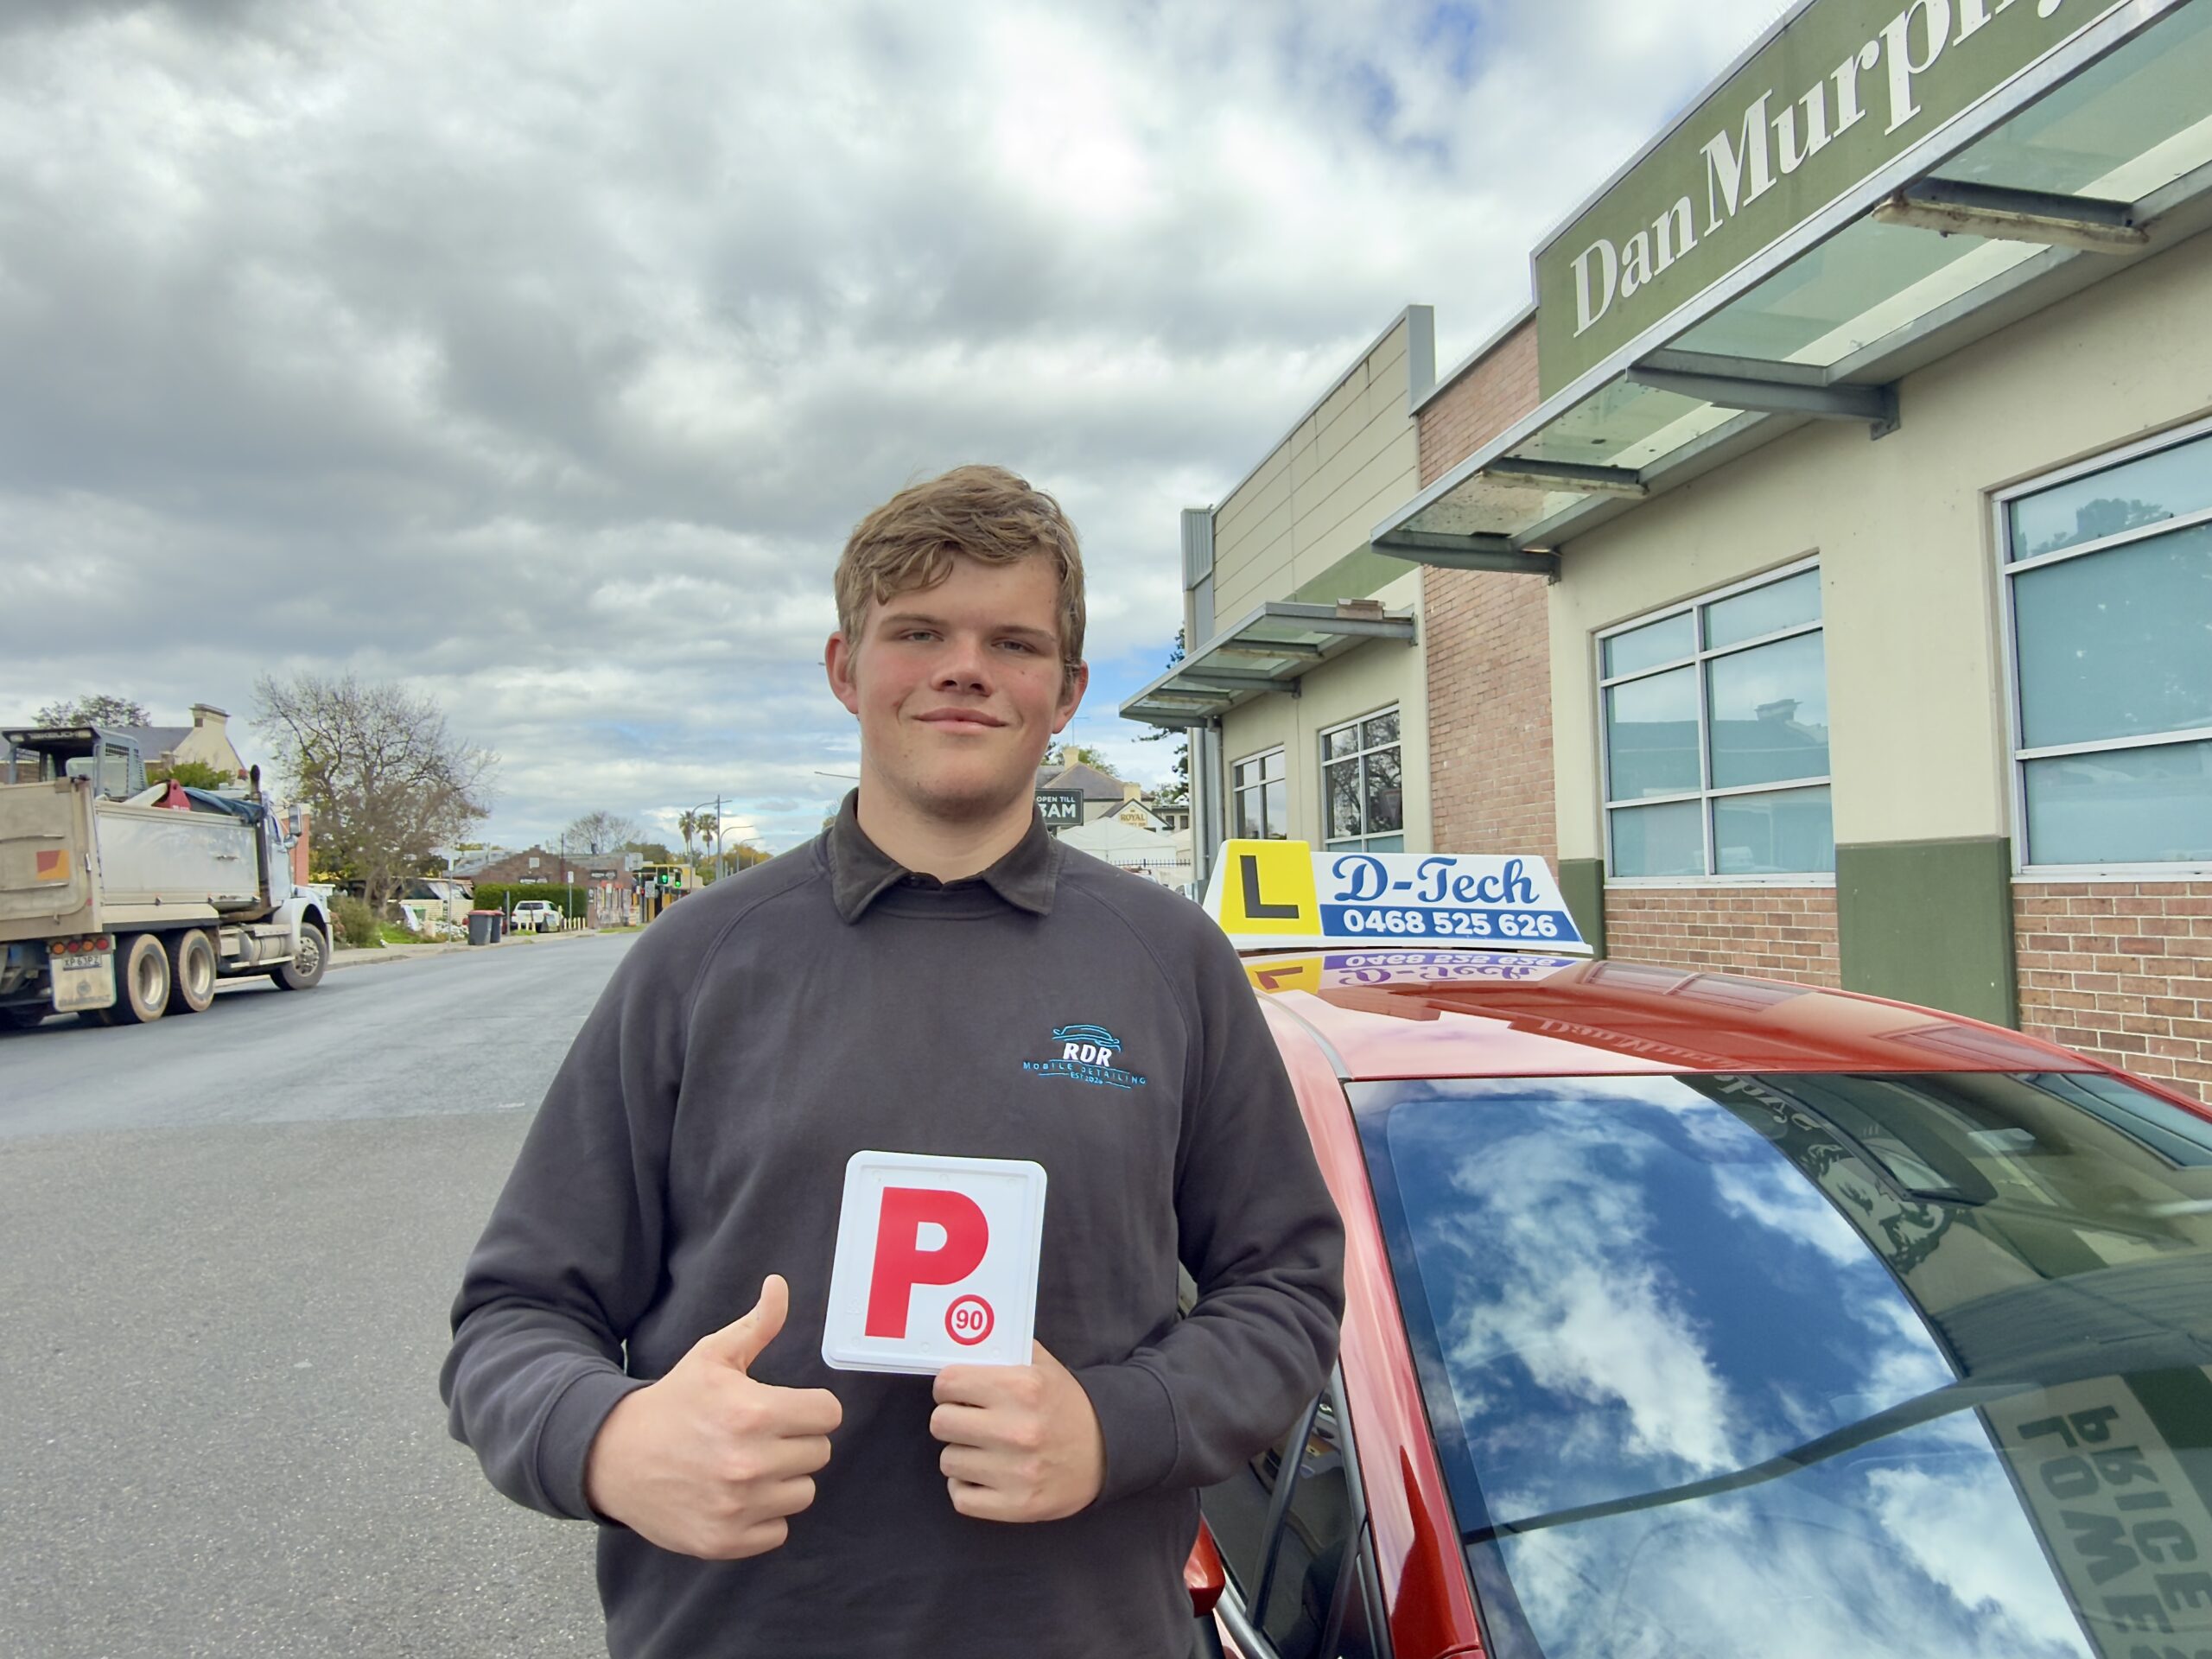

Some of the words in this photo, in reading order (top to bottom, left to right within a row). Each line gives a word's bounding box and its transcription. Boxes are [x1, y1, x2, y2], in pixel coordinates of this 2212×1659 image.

[1570, 195, 1699, 339] Dan
[1700, 0, 2061, 238] Murp
[1040, 804, 1077, 817] 3AM
[1120, 813, 1146, 822] ROYAL
[1240, 855, 1300, 919] L
[1332, 855, 1540, 905] D-Tech
[1344, 910, 1426, 934] 0468
[1433, 912, 1491, 936] 525
[1498, 914, 1558, 938] 626
[1063, 1042, 1113, 1067] RDR
[1022, 1061, 1073, 1071] MOBILE
[1080, 1066, 1147, 1085] DETAILING
[865, 1186, 989, 1339] P
[955, 1309, 983, 1331] 90
